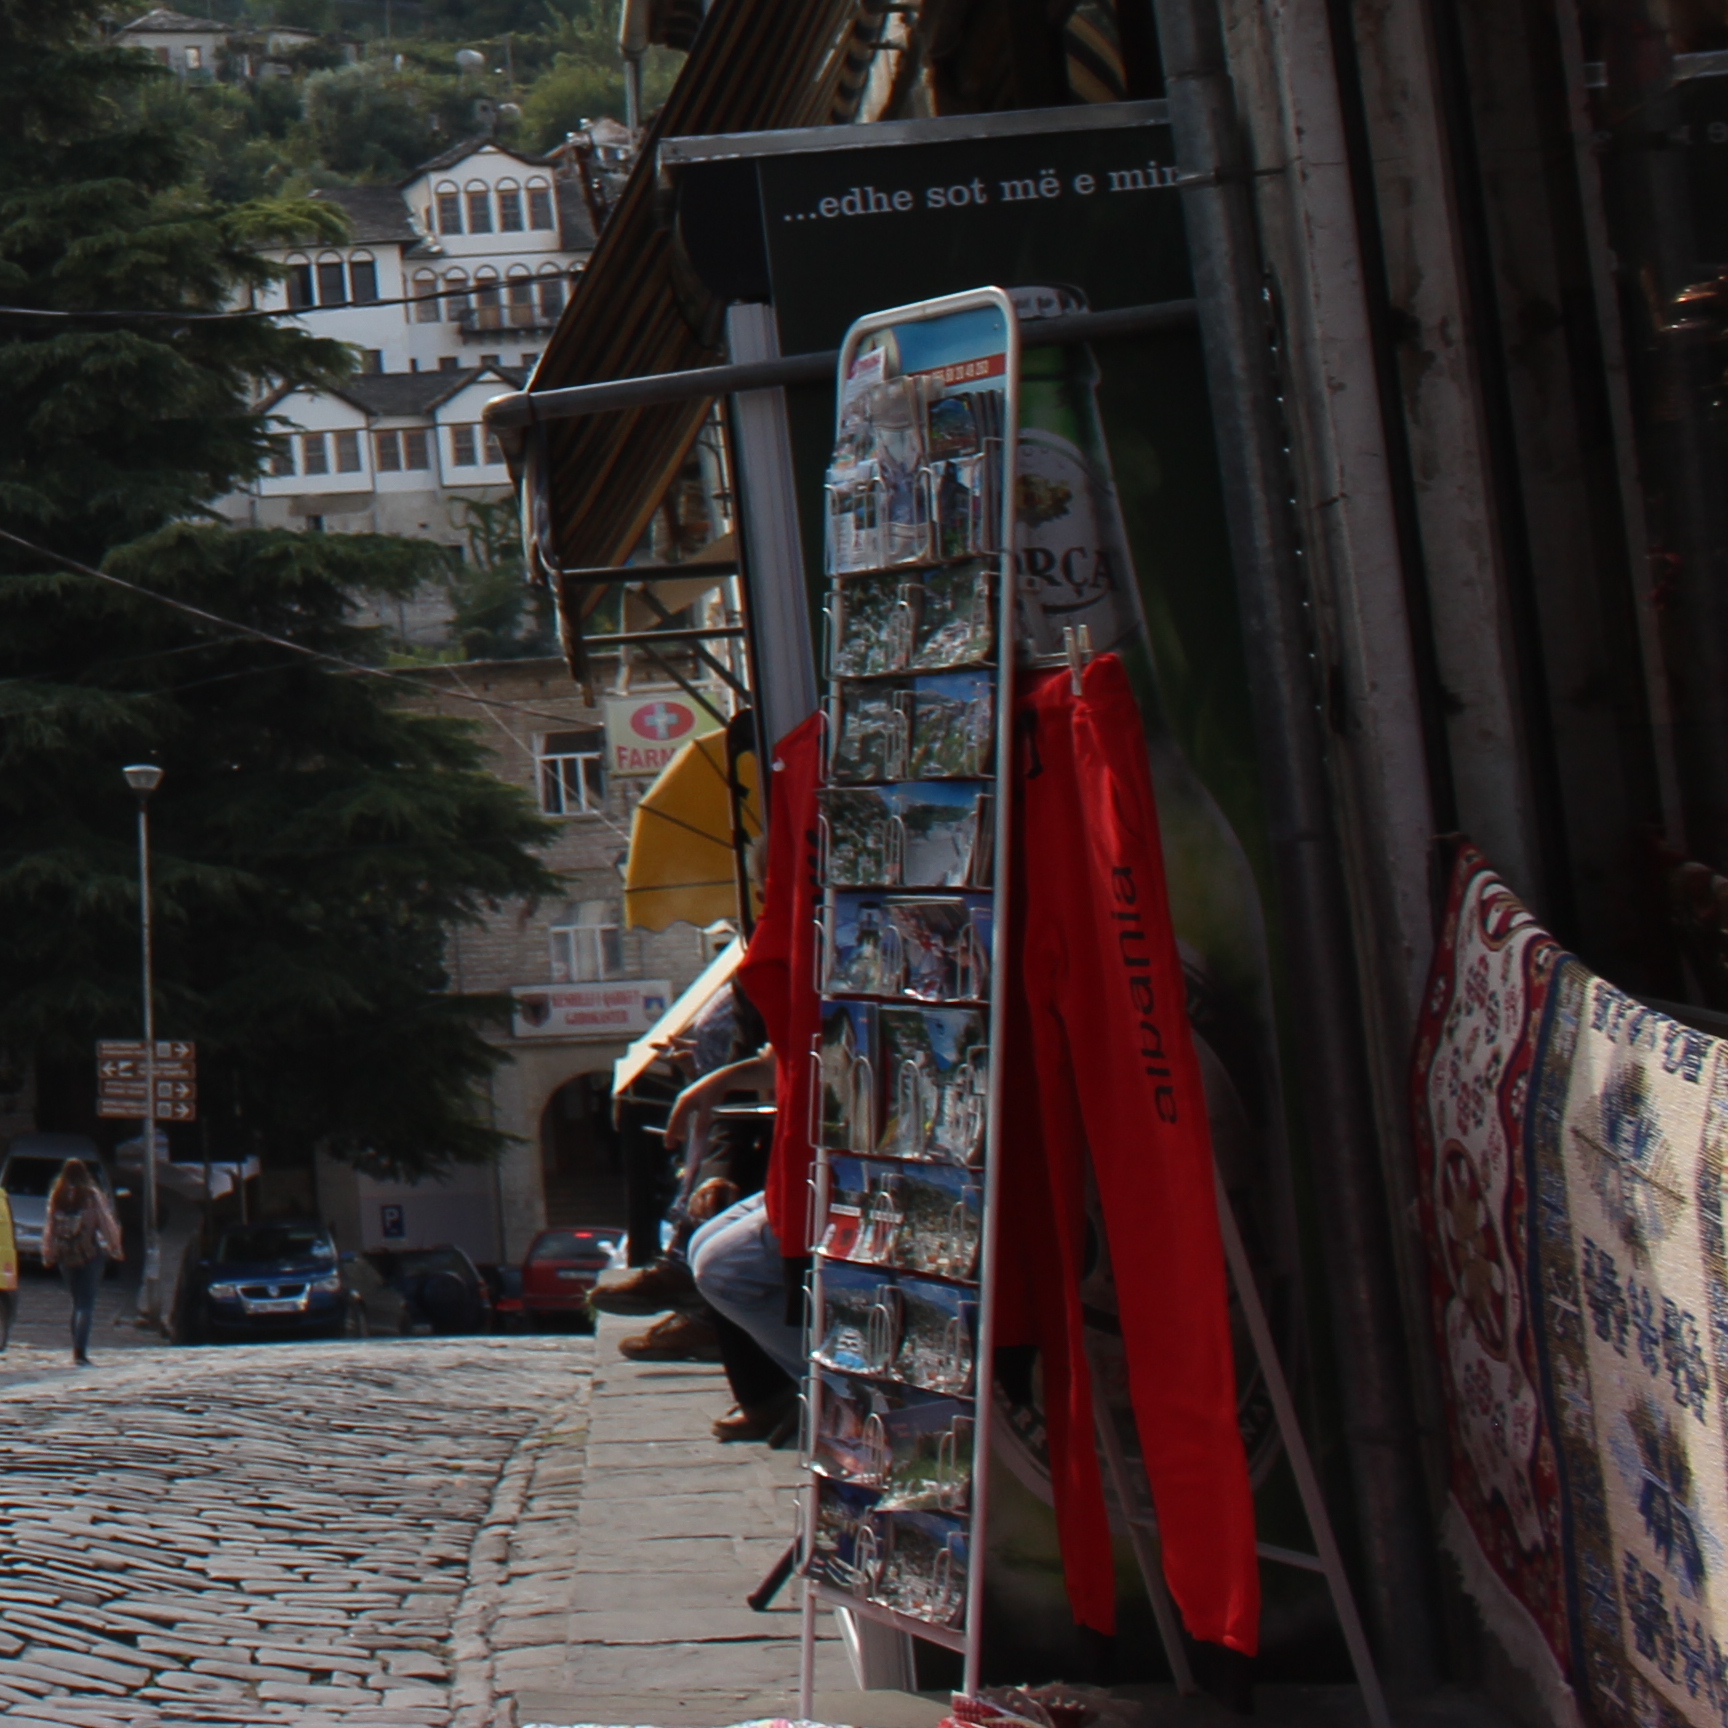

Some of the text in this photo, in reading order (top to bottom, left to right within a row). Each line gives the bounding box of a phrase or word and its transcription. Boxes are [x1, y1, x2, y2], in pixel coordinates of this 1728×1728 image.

[925, 177, 988, 209] sot
[1000, 169, 1060, 201] më
[1072, 174, 1096, 195] e
[1108, 161, 1179, 192] mir
[1014, 547, 1118, 602] RÇA
[616, 745, 677, 770] FAR
